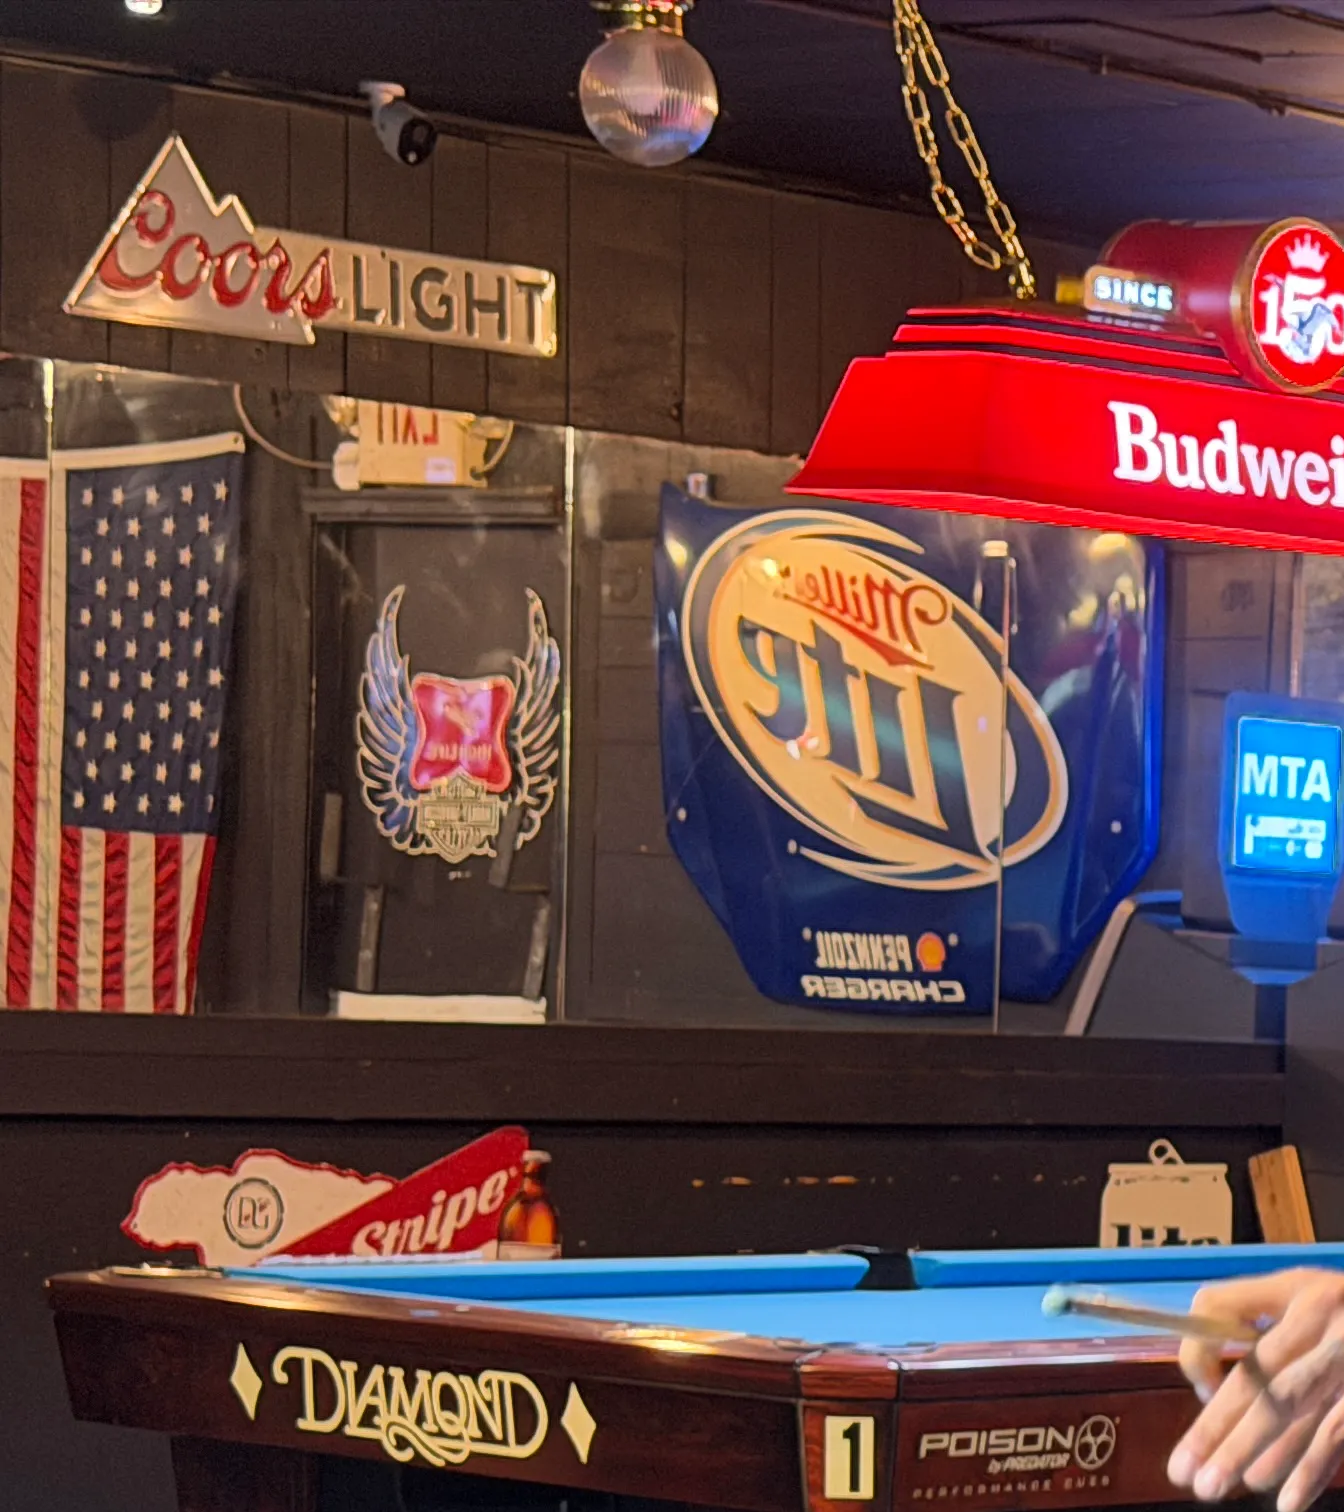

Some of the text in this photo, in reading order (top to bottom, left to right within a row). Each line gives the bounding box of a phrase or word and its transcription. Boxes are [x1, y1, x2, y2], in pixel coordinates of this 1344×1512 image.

[100, 190, 548, 345] Coors LIGHT
[1094, 275, 1173, 311] SINCE
[352, 1166, 506, 1257] Stripe
[272, 1345, 550, 1467] DIAMOND
[918, 1424, 1076, 1460] POISON
[840, 1421, 864, 1494] 1
[1001, 1452, 1072, 1473] PREDATOR
